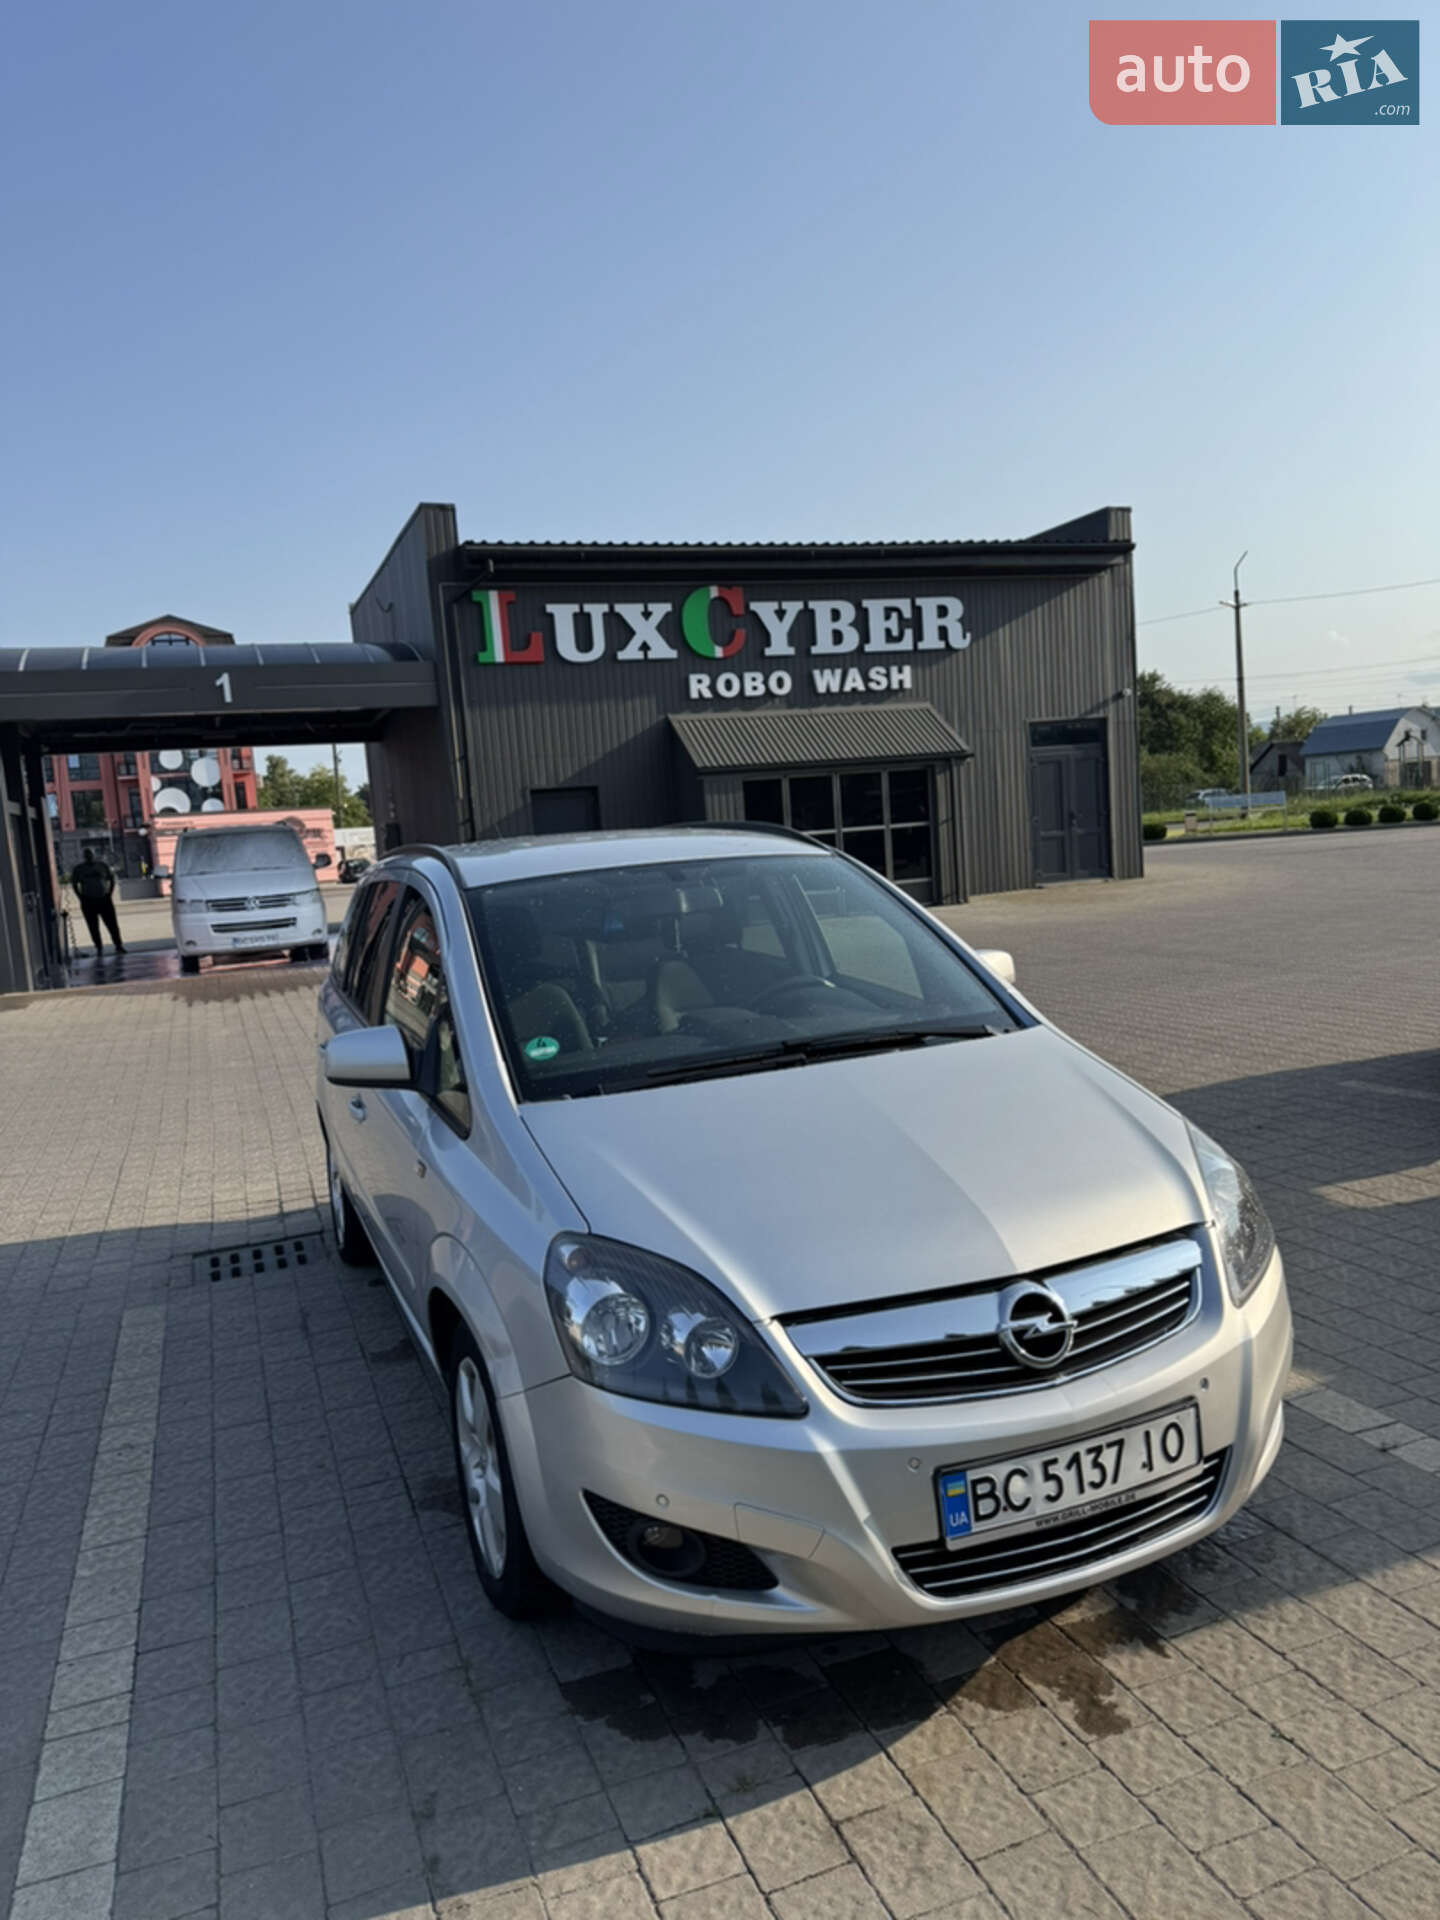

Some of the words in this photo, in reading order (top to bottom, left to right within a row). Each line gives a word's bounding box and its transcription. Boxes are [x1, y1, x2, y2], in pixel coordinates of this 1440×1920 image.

[215, 672, 232, 703] 1
[688, 670, 792, 699] ROBO
[812, 665, 913, 694] WASH
[970, 1467, 1032, 1523] BC
[1041, 1438, 1125, 1503] 5137
[950, 1511, 969, 1528] UA
